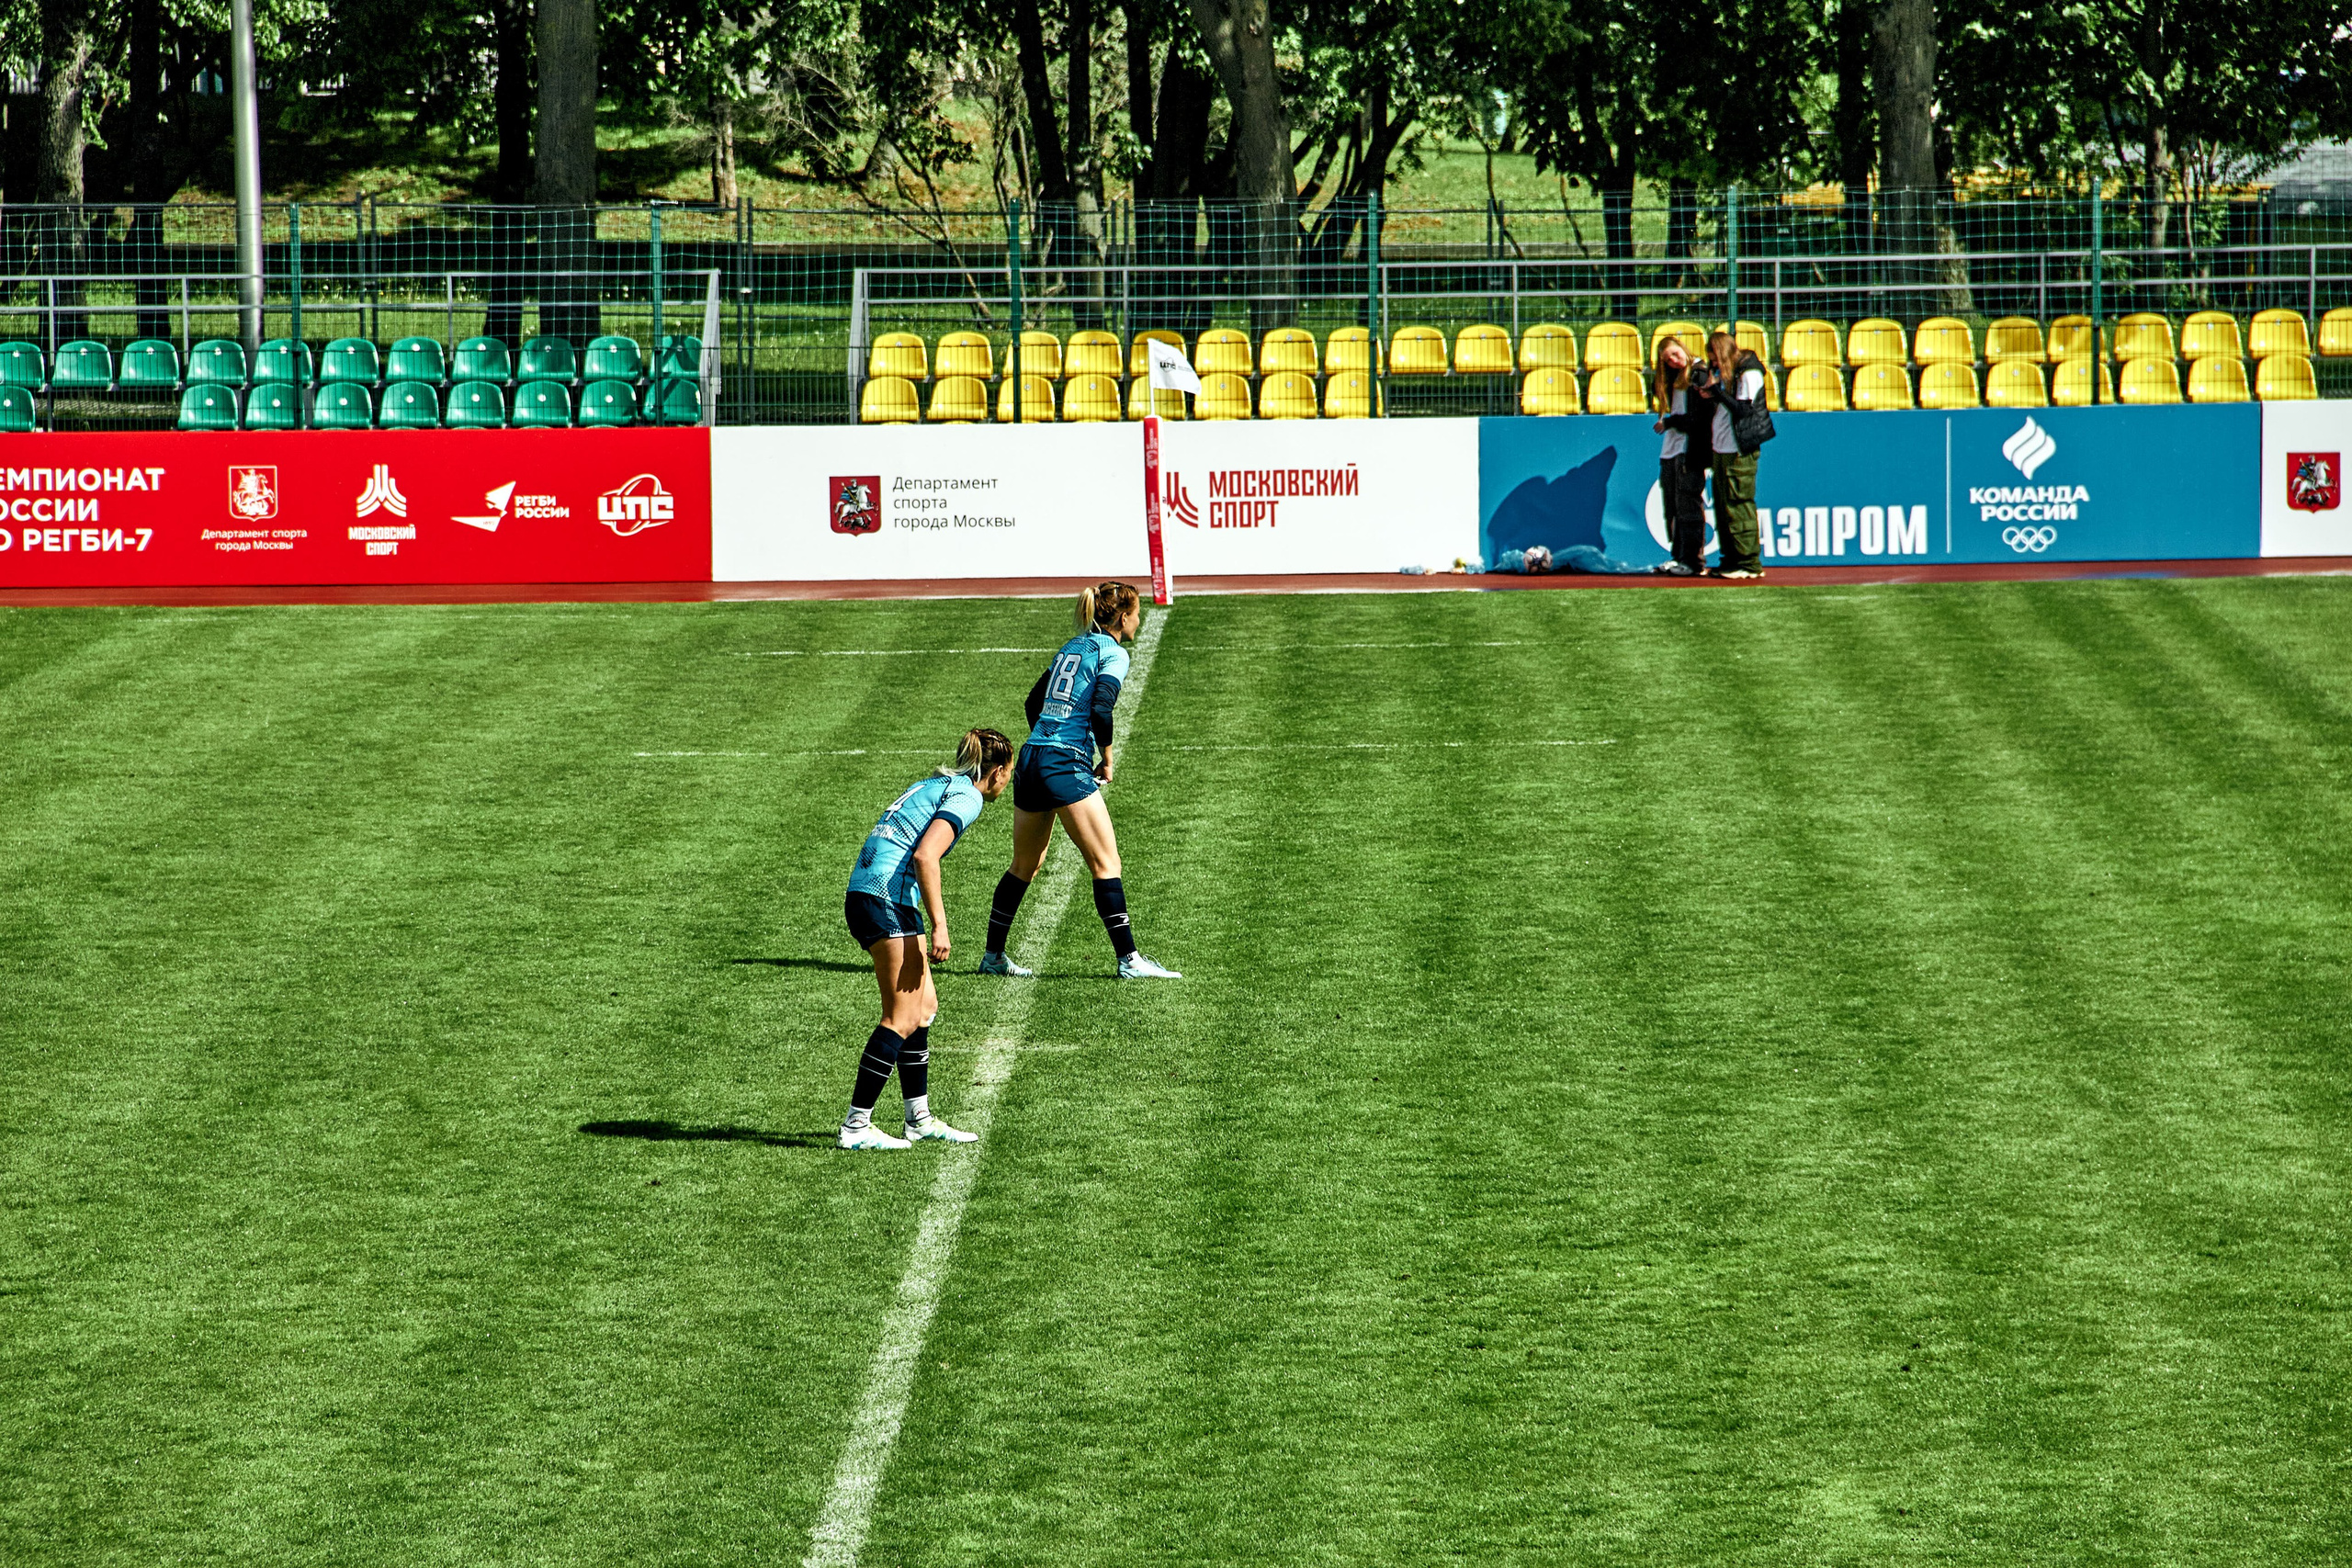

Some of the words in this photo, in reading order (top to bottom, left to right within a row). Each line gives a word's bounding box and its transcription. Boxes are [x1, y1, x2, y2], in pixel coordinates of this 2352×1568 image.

[0, 468, 165, 491] МПИОНАТ
[893, 476, 999, 493] Департамент
[1209, 462, 1359, 498] МОСКОВСКИЙ
[514, 494, 557, 507] РЕГБИ
[893, 497, 948, 512] спорта
[1969, 485, 2091, 505] КОМАНДА
[514, 506, 570, 519] РОССИИ
[597, 496, 674, 521] ЦПС
[1209, 501, 1279, 529] СПОРТ
[1980, 503, 2078, 522] РОССИИ
[347, 524, 416, 540] МОСКОВСКИЙ
[894, 516, 949, 532] города
[954, 514, 1016, 528] Москвы
[1756, 505, 1928, 558] АЗПРОМ
[22, 528, 153, 552] РЕГБИ-7
[200, 528, 269, 540] Департамент
[272, 529, 308, 540] спорта
[215, 541, 252, 552] города
[253, 540, 294, 550] Москвы
[365, 541, 399, 556] СПОРТ
[1045, 652, 1082, 702] 18
[884, 784, 927, 822] 4
